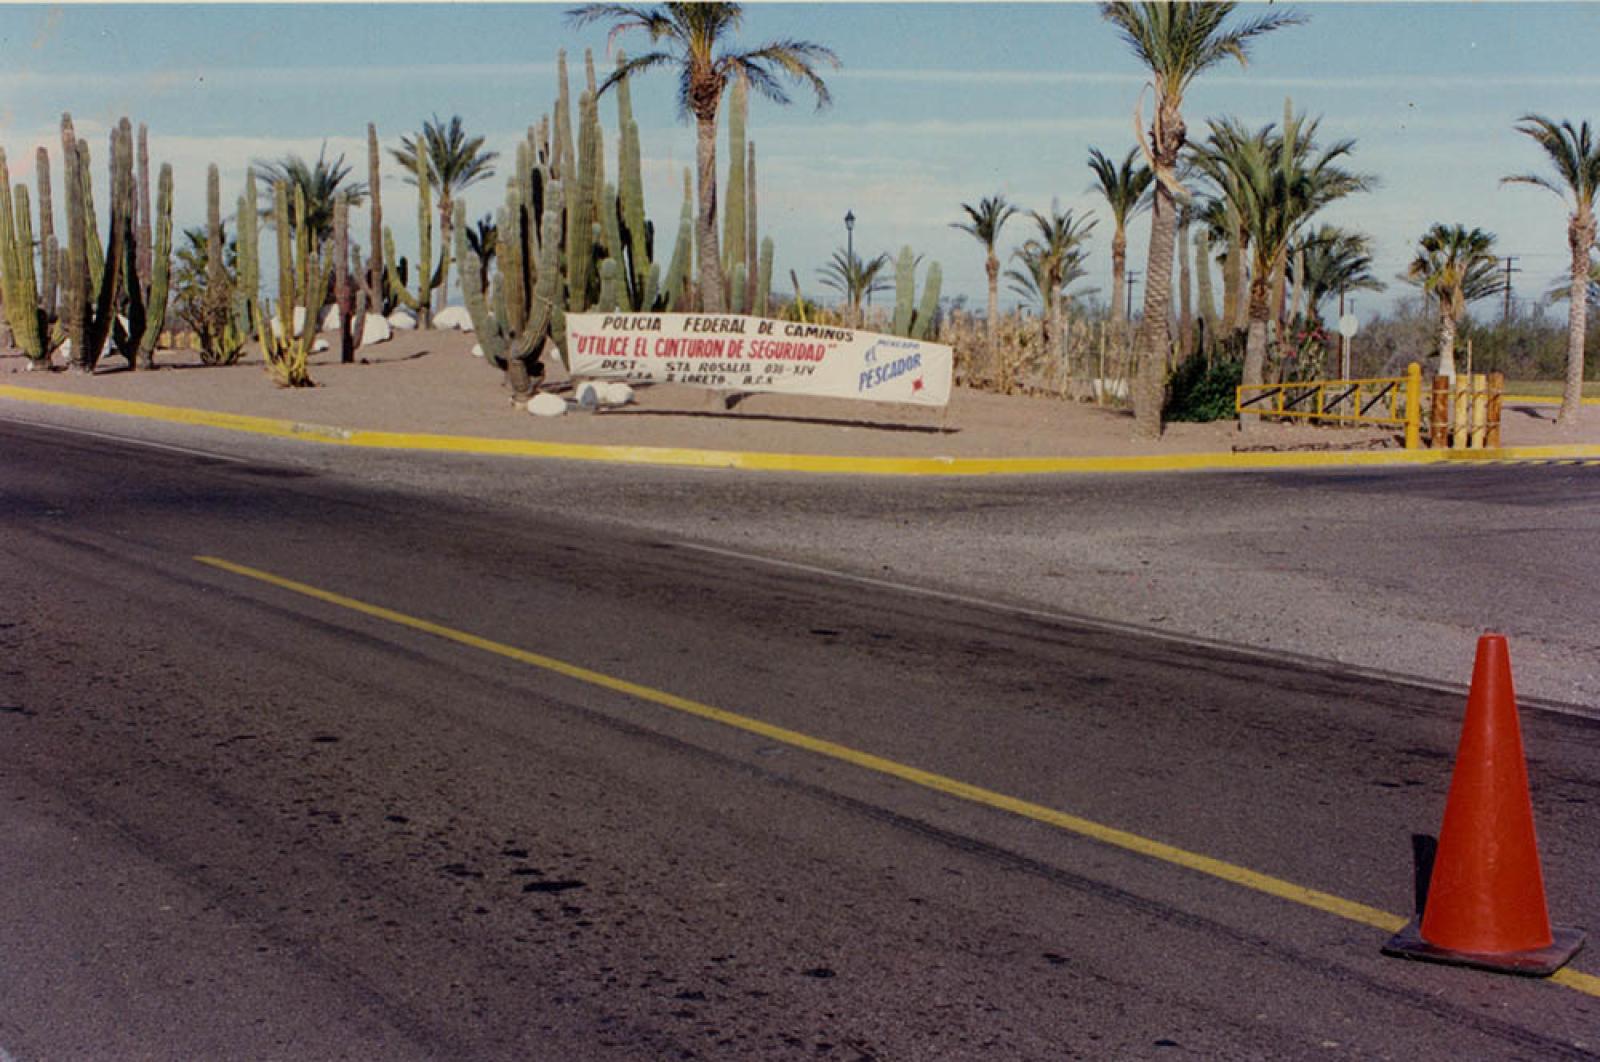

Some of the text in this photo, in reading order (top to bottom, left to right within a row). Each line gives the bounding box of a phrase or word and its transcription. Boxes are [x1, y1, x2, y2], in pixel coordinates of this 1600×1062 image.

[602, 316, 853, 342] POLICIA FEDERAL DE CAMINOS
[634, 337, 648, 357] EL
[655, 338, 725, 359] CINTURON
[728, 339, 744, 359] DE
[858, 353, 921, 392] PESCADOR
